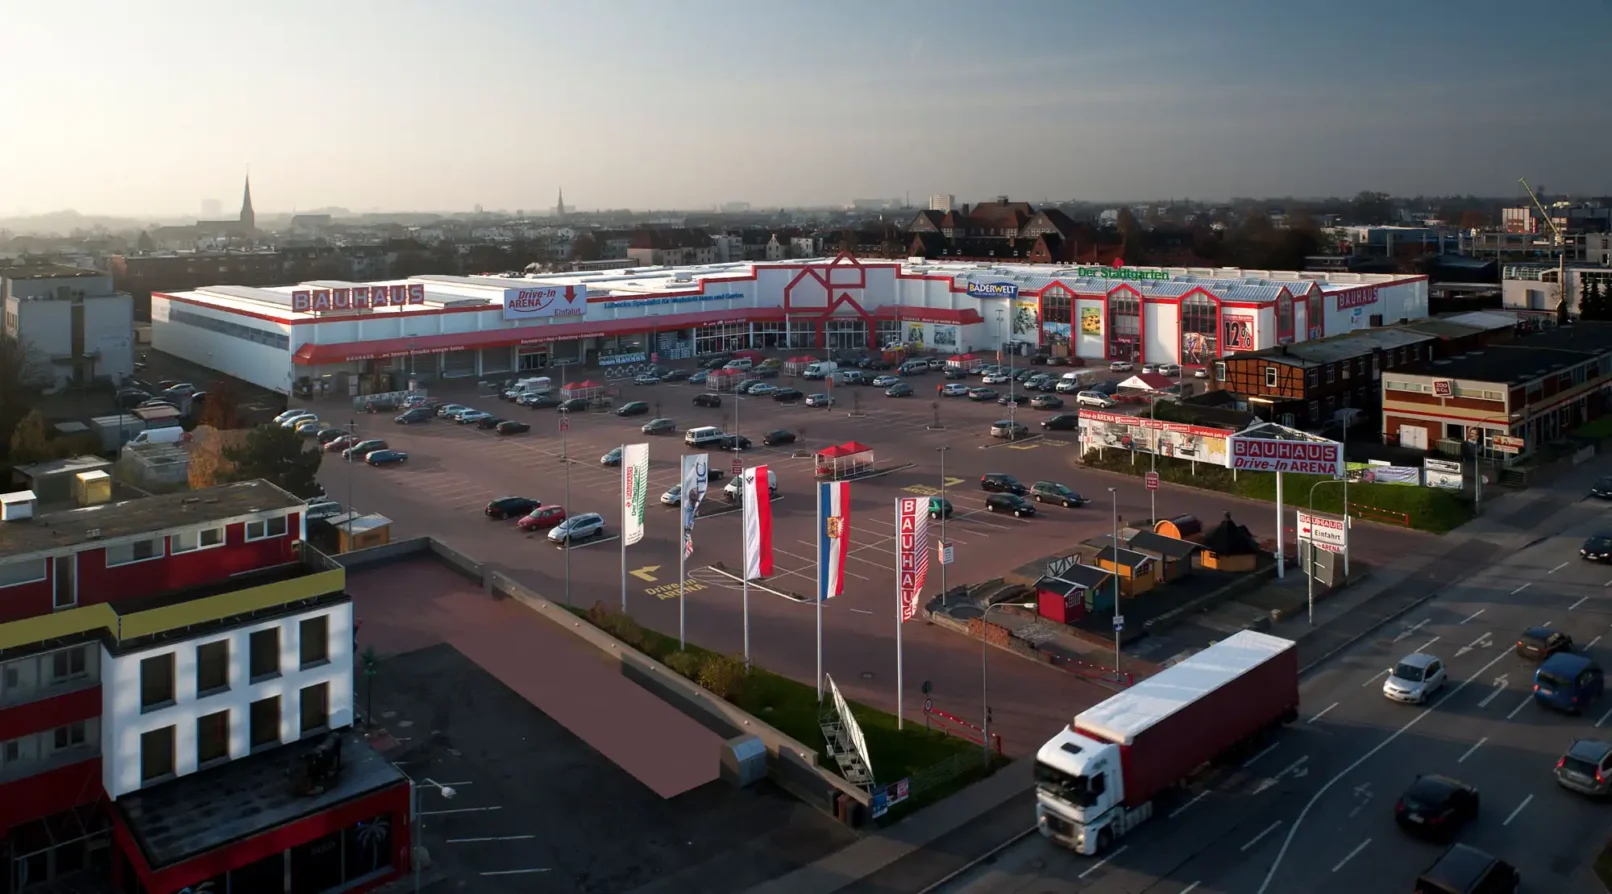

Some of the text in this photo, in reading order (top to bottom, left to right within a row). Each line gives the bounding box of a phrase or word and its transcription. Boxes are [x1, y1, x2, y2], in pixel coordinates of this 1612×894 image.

[1078, 267, 1169, 281] Der Stadtgarten
[294, 284, 422, 310] BAUHAUS
[519, 289, 556, 300] Drive-In
[1339, 287, 1378, 306] BAUHAUS
[509, 299, 541, 309] ARENA
[554, 308, 581, 317] Einfahrt
[1096, 413, 1115, 423] ARENA
[1235, 442, 1335, 460] BAUHAUS
[1234, 457, 1336, 474] Drive-In ARENA
[1300, 515, 1343, 530] BAUHAUS
[1314, 530, 1341, 540] Einfahrt
[1321, 544, 1341, 552] ARENA
[902, 500, 915, 620] BAUHAUS
[656, 584, 708, 600] ARENA
